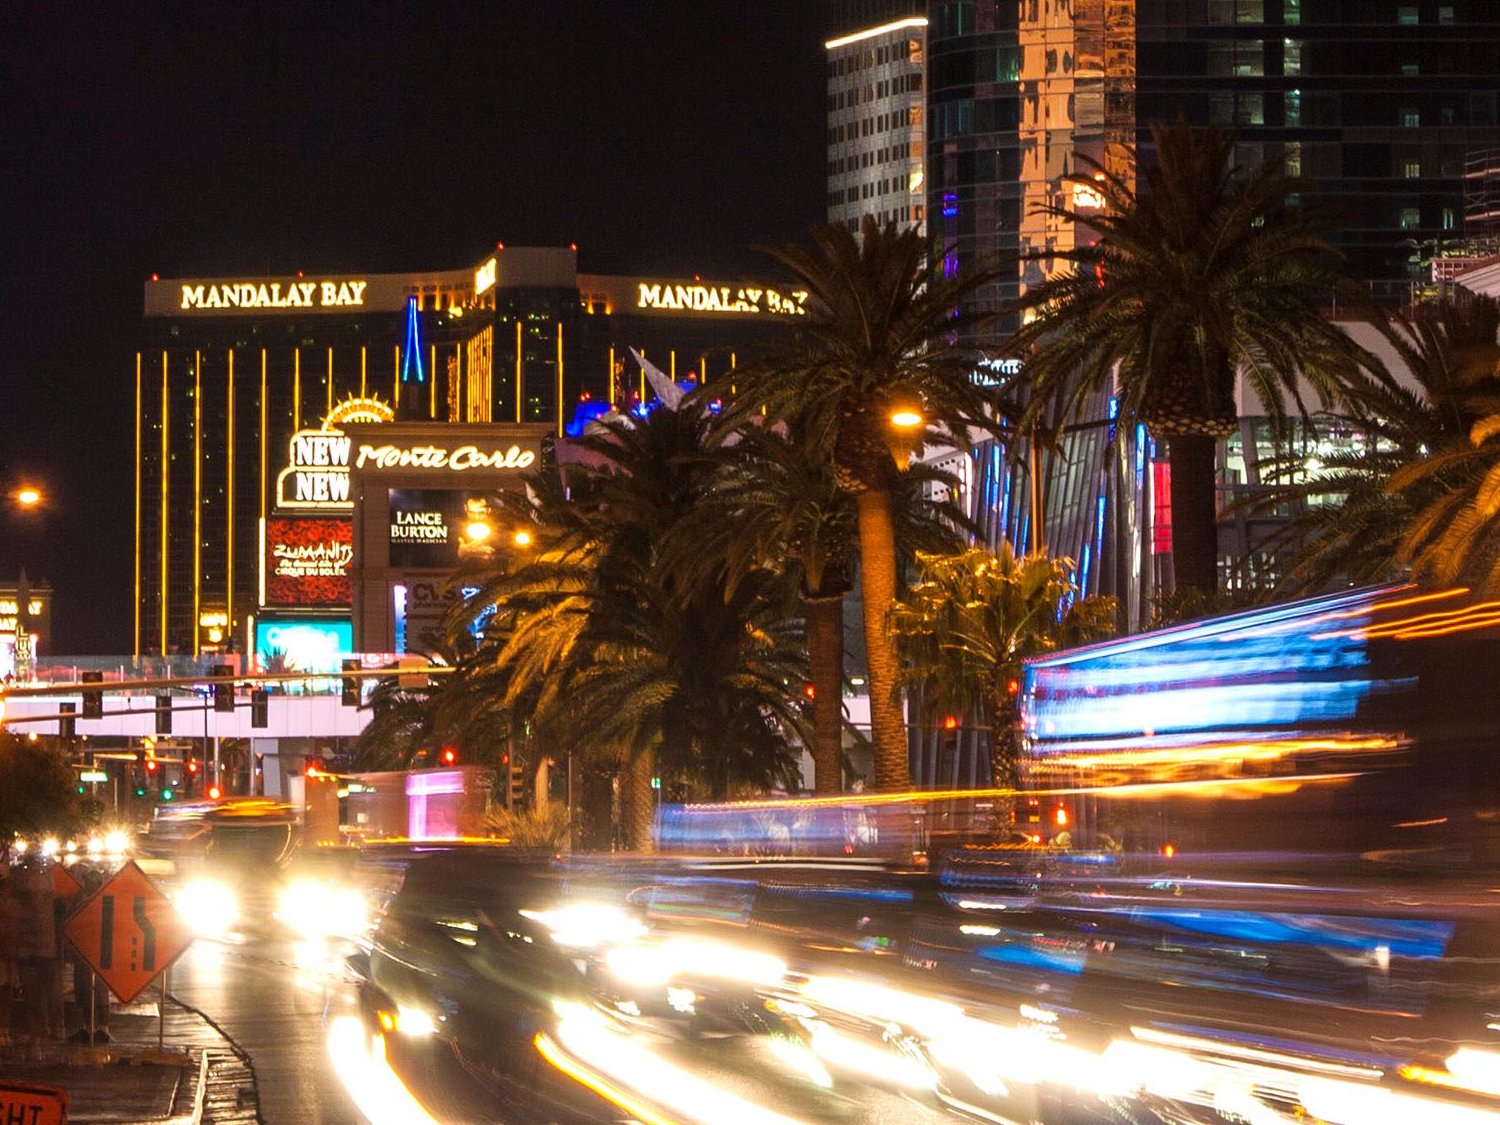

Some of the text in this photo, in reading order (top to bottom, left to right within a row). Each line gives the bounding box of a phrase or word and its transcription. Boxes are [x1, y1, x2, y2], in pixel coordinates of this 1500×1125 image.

[181, 281, 367, 309] MANDALAY BAY
[637, 283, 763, 313] MANDALAY
[296, 436, 351, 466] NEW
[355, 444, 535, 470] Monte Carlo
[296, 472, 350, 502] NEW
[390, 524, 448, 538] BURTON
[396, 511, 442, 525] LANCE
